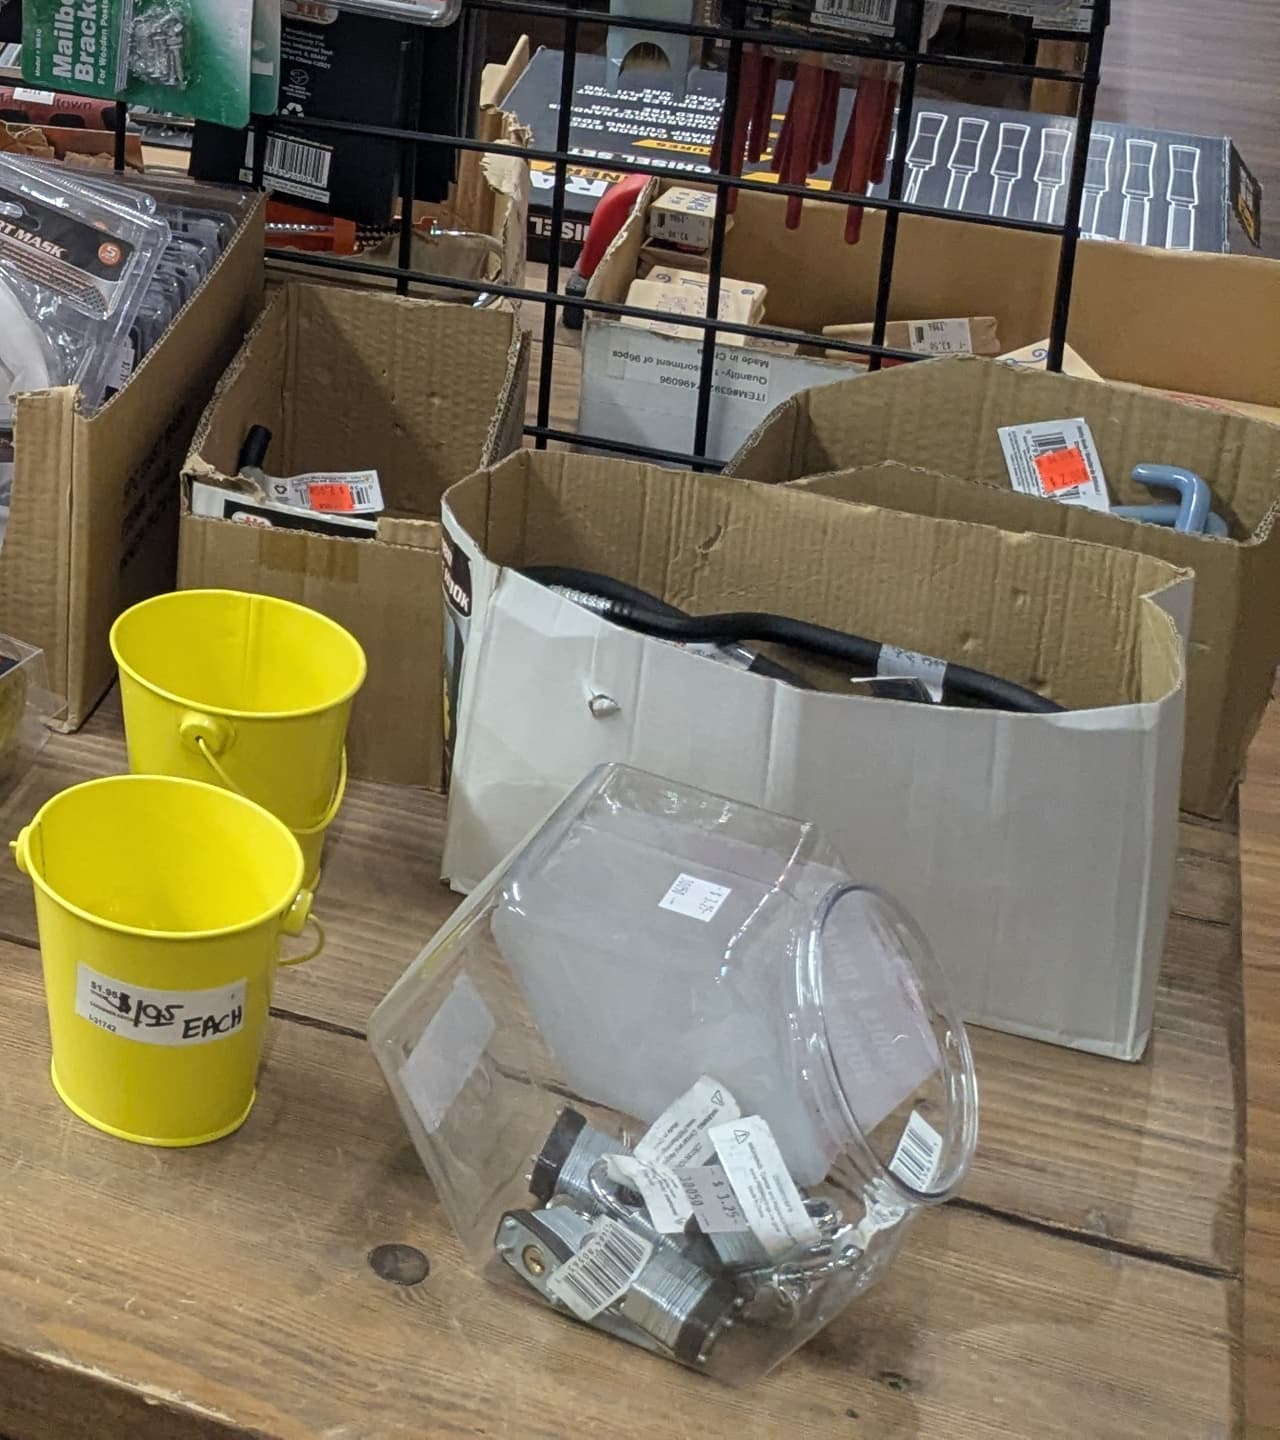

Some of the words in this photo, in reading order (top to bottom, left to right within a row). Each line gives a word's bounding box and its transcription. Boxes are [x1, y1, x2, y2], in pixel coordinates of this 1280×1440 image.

[99, 28, 108, 66] Wooden
[98, 69, 106, 85] For
[623, 153, 712, 174] CHISEL
[14, 229, 67, 258] MASK
[741, 354, 769, 368] Made
[181, 1007, 244, 1040] EACH
